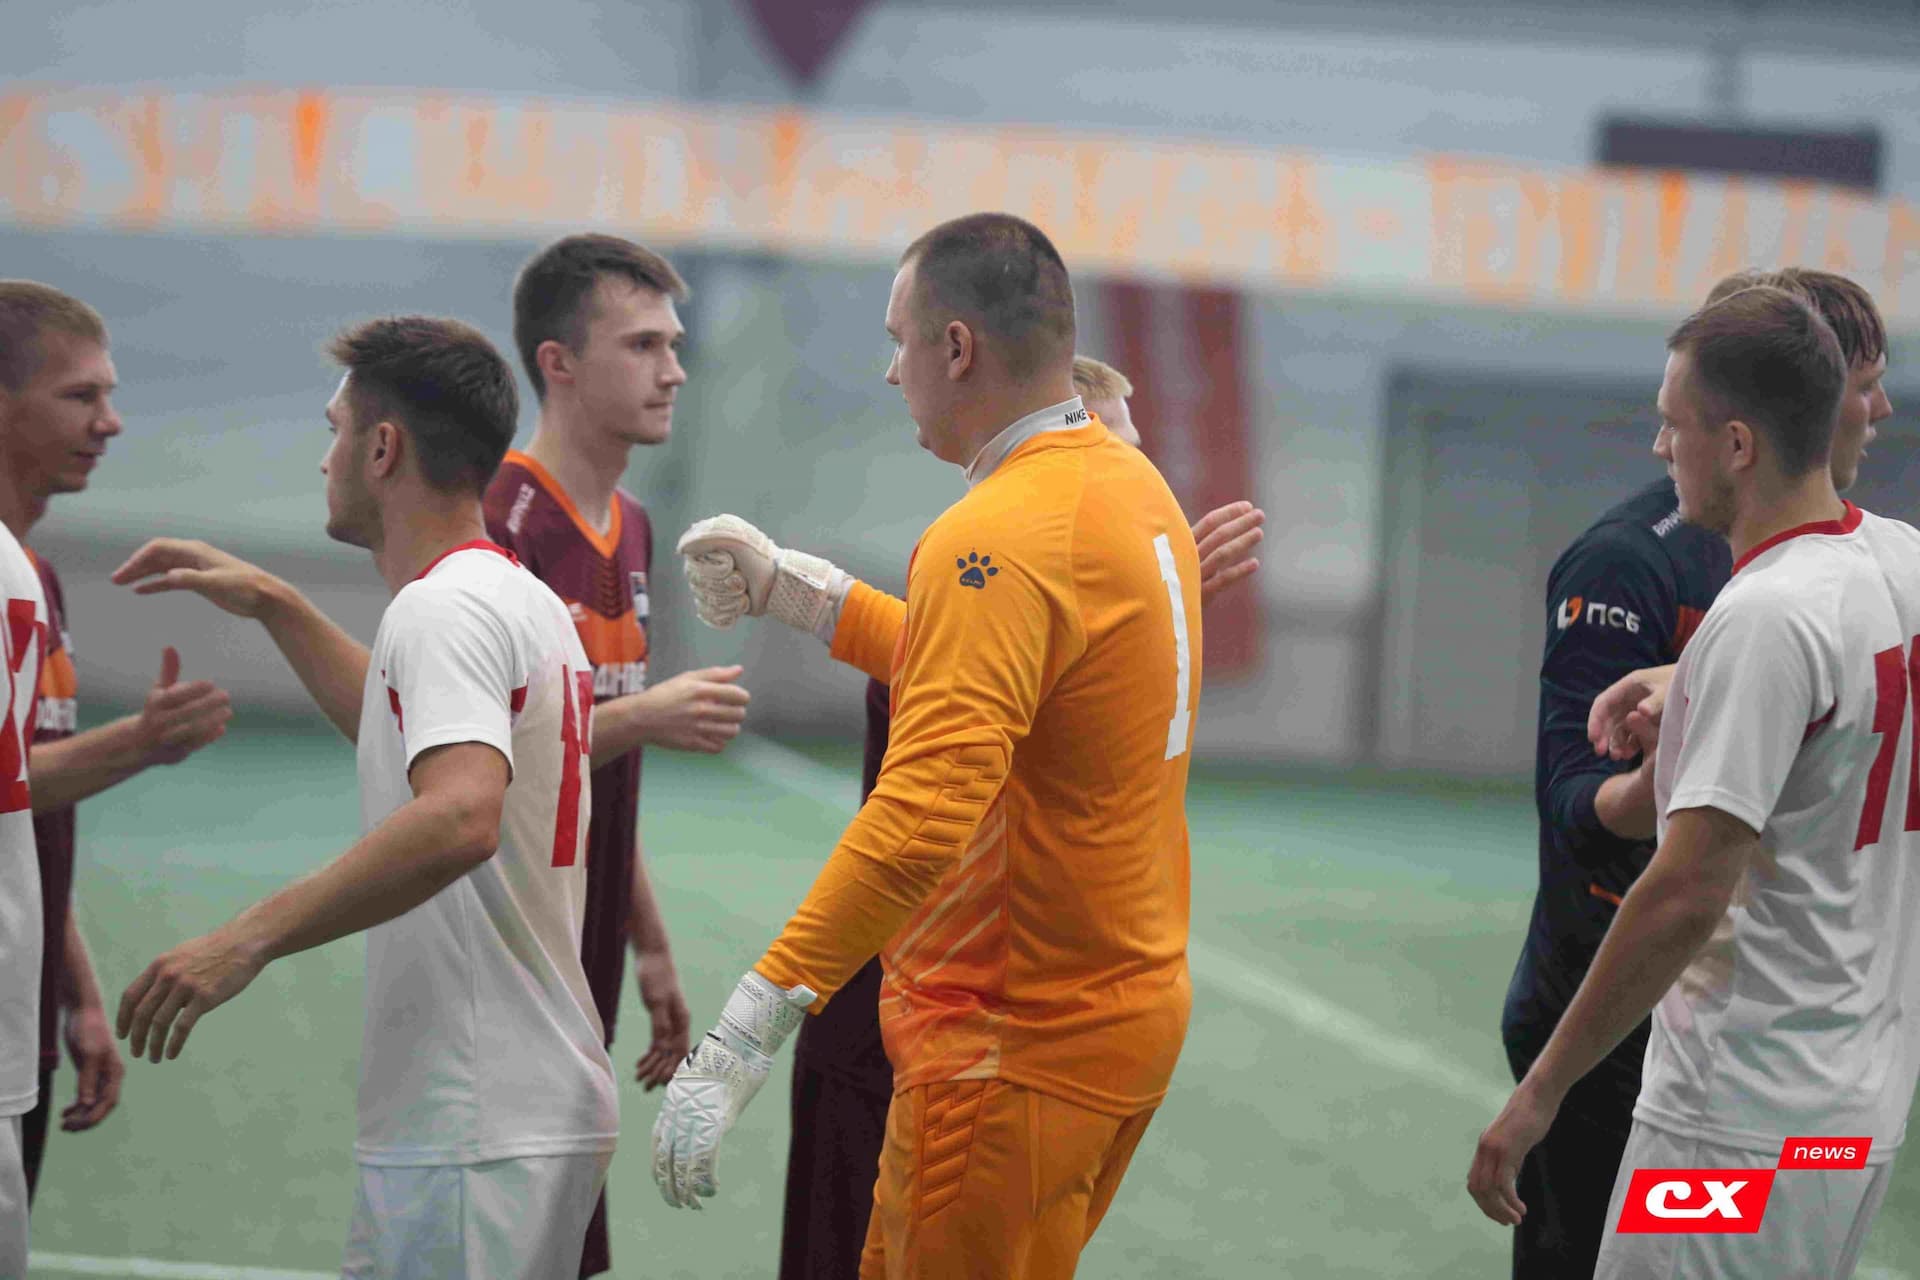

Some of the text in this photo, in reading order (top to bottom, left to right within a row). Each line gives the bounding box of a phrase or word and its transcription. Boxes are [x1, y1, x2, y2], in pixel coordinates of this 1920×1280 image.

[1065, 408, 1087, 425] NIKE
[1586, 602, 1641, 634] ПСБ
[1153, 533, 1191, 760] 1
